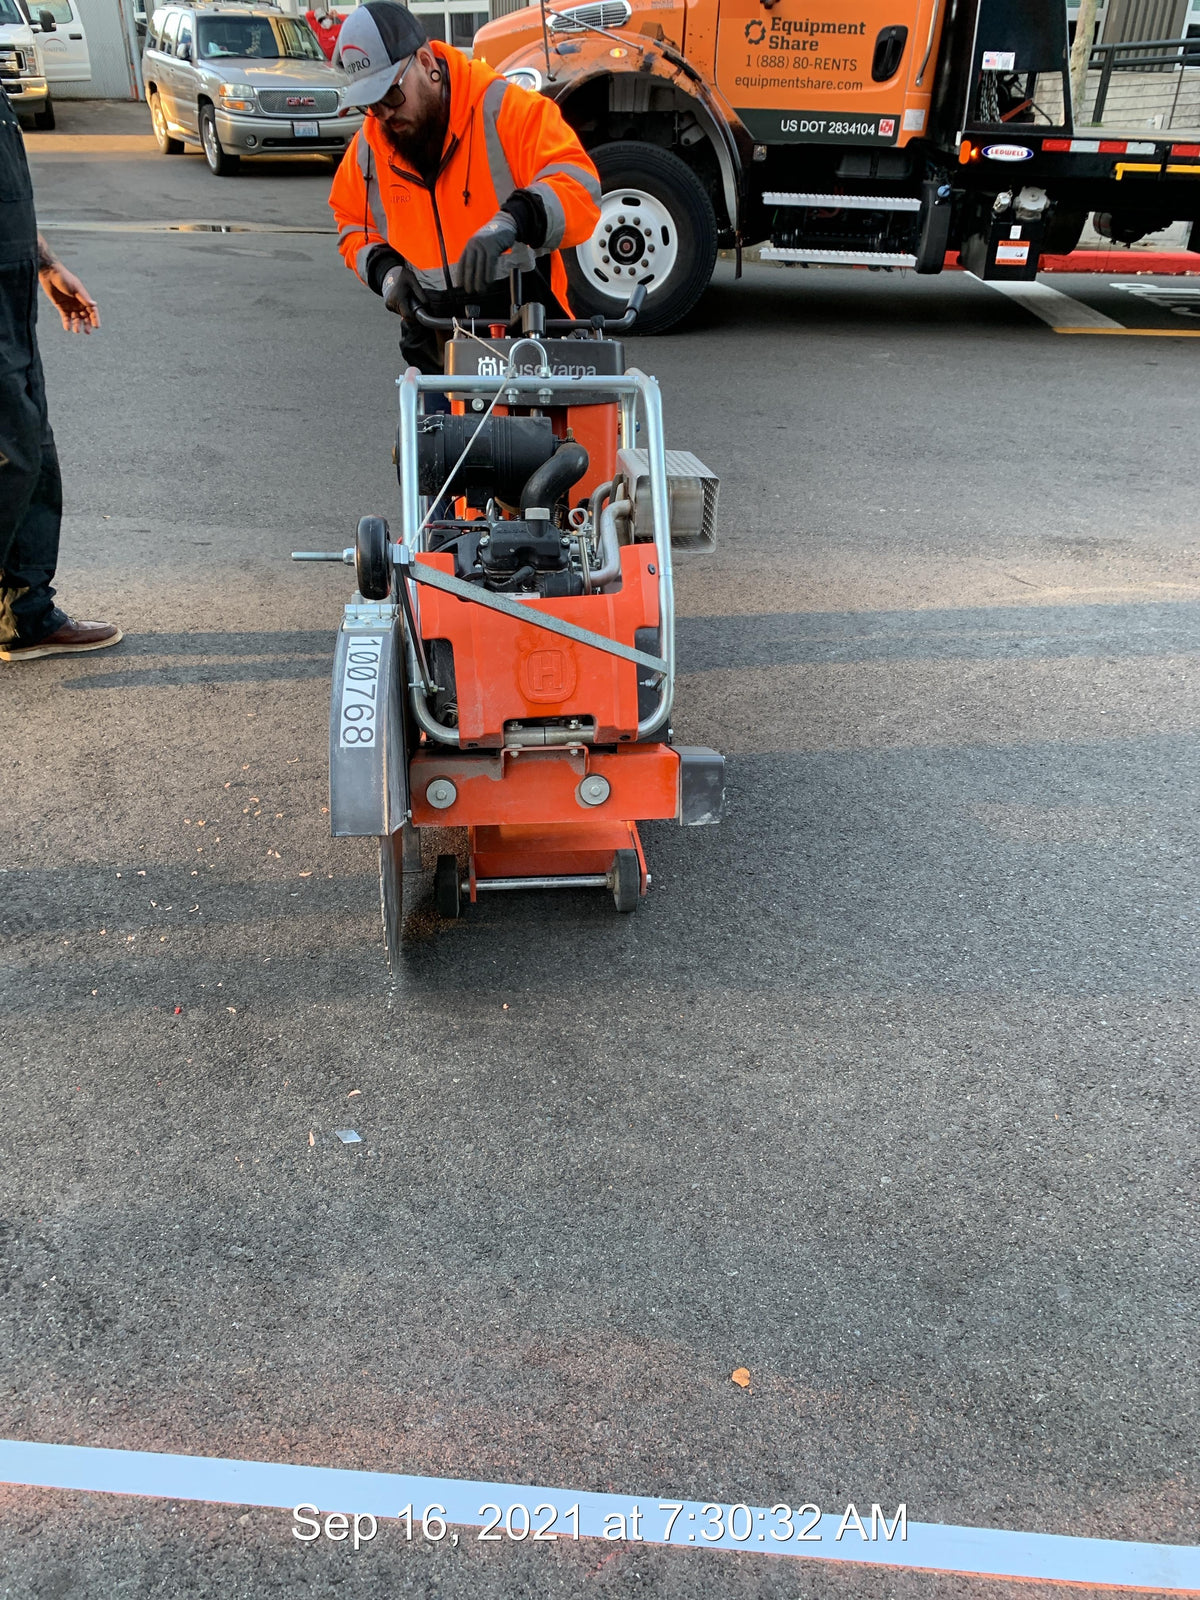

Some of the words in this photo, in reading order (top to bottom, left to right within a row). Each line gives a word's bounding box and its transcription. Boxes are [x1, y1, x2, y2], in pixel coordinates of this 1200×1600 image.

[770, 16, 866, 36] Equipment
[768, 35, 819, 52] Share
[746, 55, 752, 67] 1
[756, 54, 790, 69] (888)
[792, 56, 858, 72] 80-RENTS
[735, 74, 863, 91] equipmentshare.com
[286, 96, 316, 107] GMC
[780, 119, 798, 132] US
[800, 120, 827, 133] DOT
[828, 121, 875, 136] 2834104
[990, 148, 1024, 157] LEDWELL
[342, 639, 381, 745] 100768
